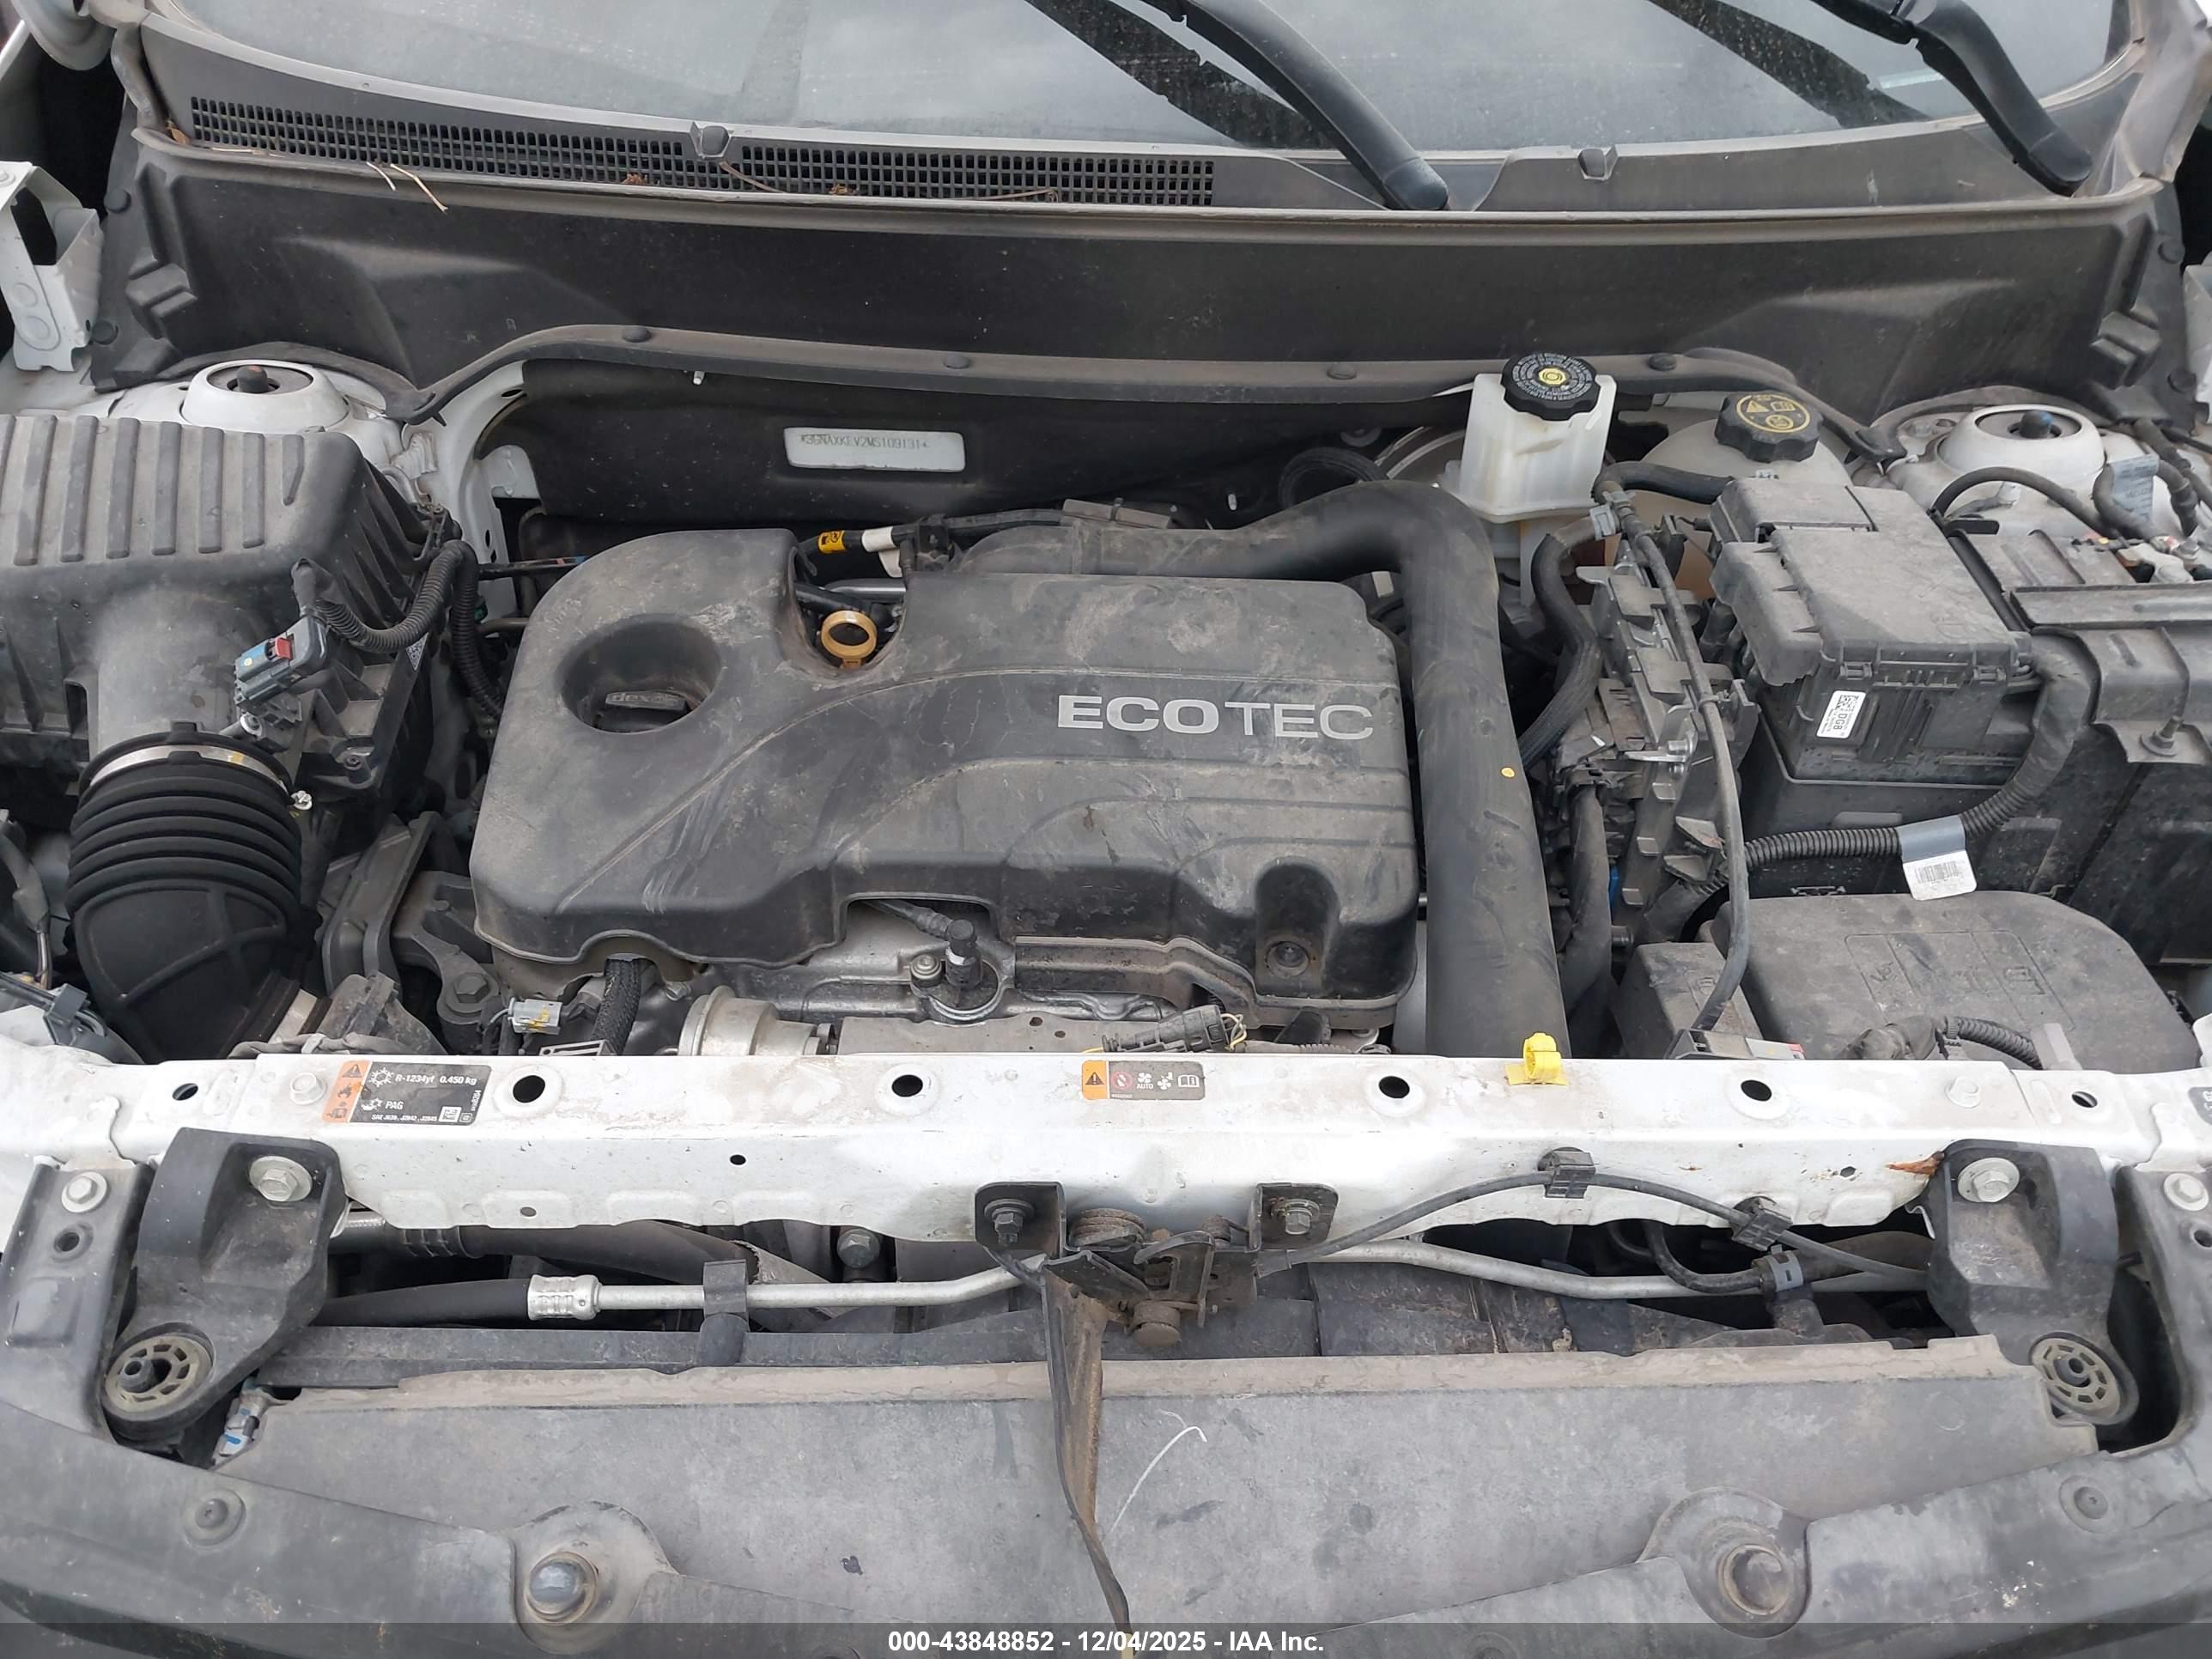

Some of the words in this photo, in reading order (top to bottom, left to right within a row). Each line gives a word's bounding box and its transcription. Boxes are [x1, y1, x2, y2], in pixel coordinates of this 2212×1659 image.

[1057, 694, 1374, 740] ECOTEC
[395, 1074, 435, 1084] R-1234yf
[439, 1075, 465, 1084] 0.450
[465, 1076, 477, 1086] kg
[385, 1100, 404, 1109] PAG
